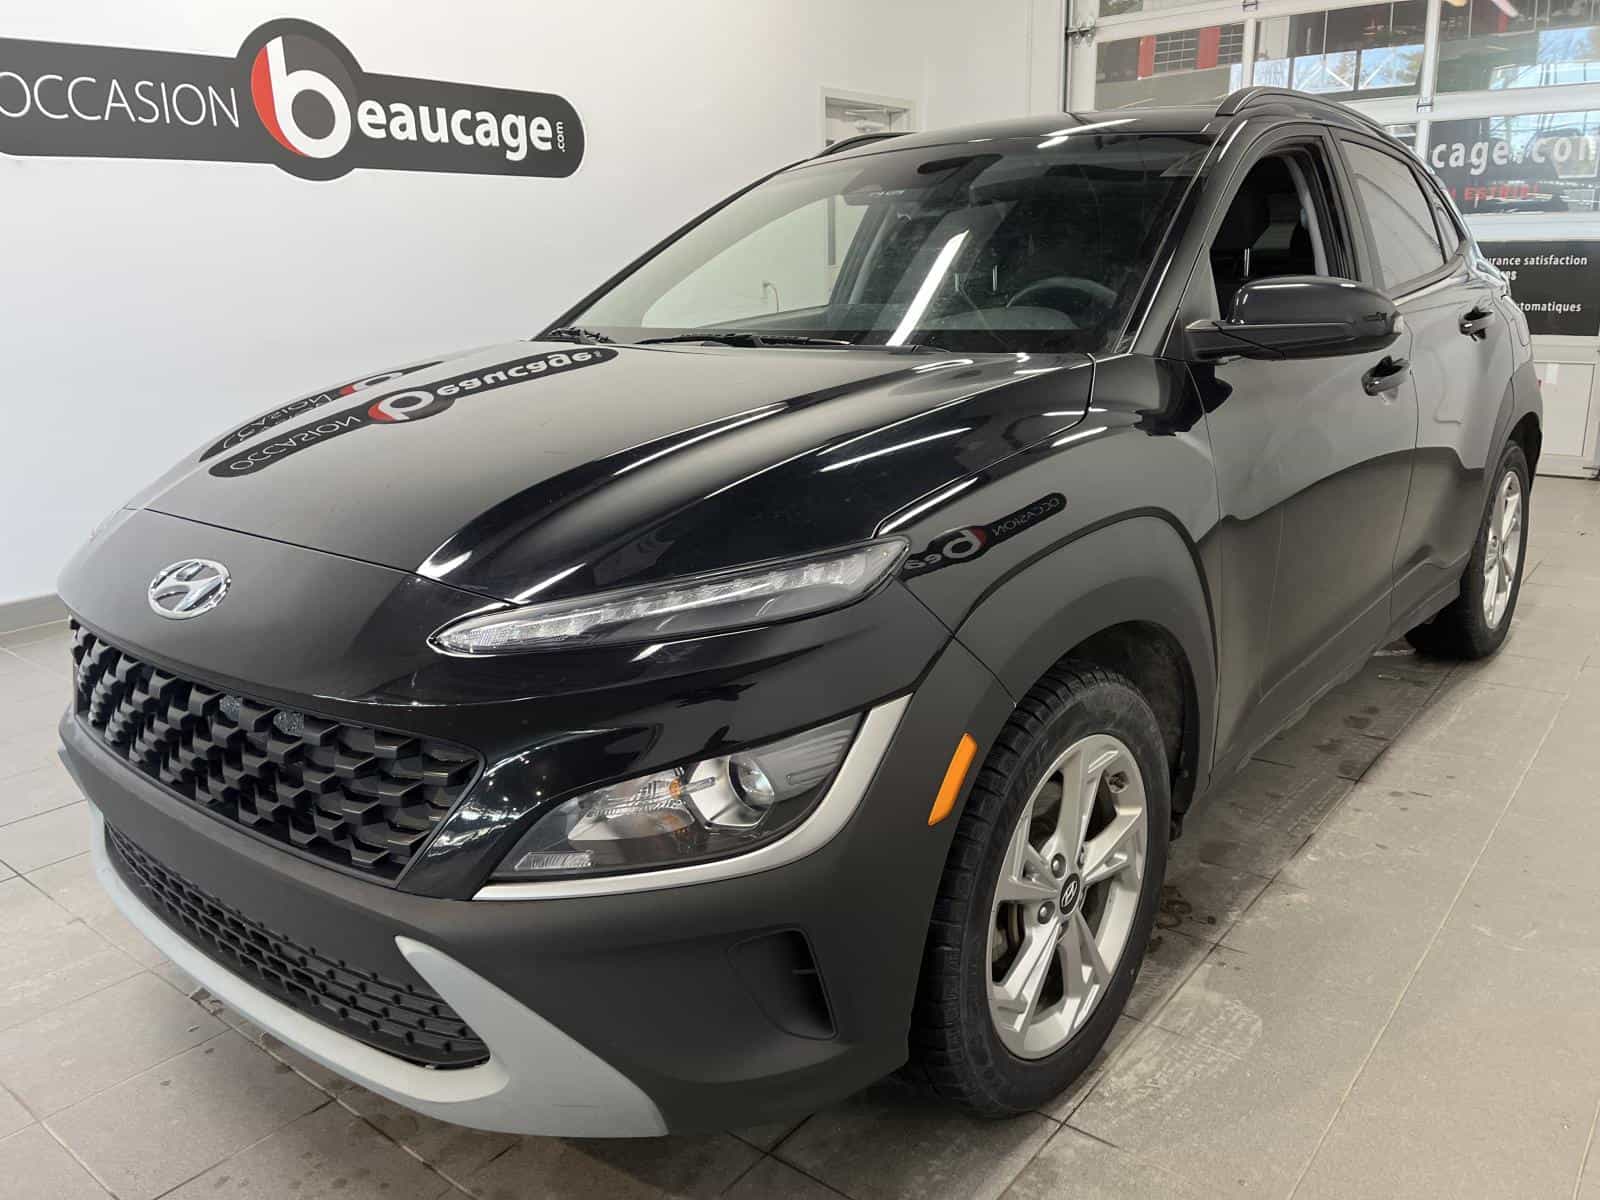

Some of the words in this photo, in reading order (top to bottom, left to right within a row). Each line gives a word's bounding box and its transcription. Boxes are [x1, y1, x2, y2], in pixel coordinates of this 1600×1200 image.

[0, 71, 240, 129] OCCASION
[252, 35, 554, 161] beaucage
[555, 121, 566, 153] .com
[1523, 254, 1588, 266] satisfaction
[1517, 301, 1583, 315] tomatiques
